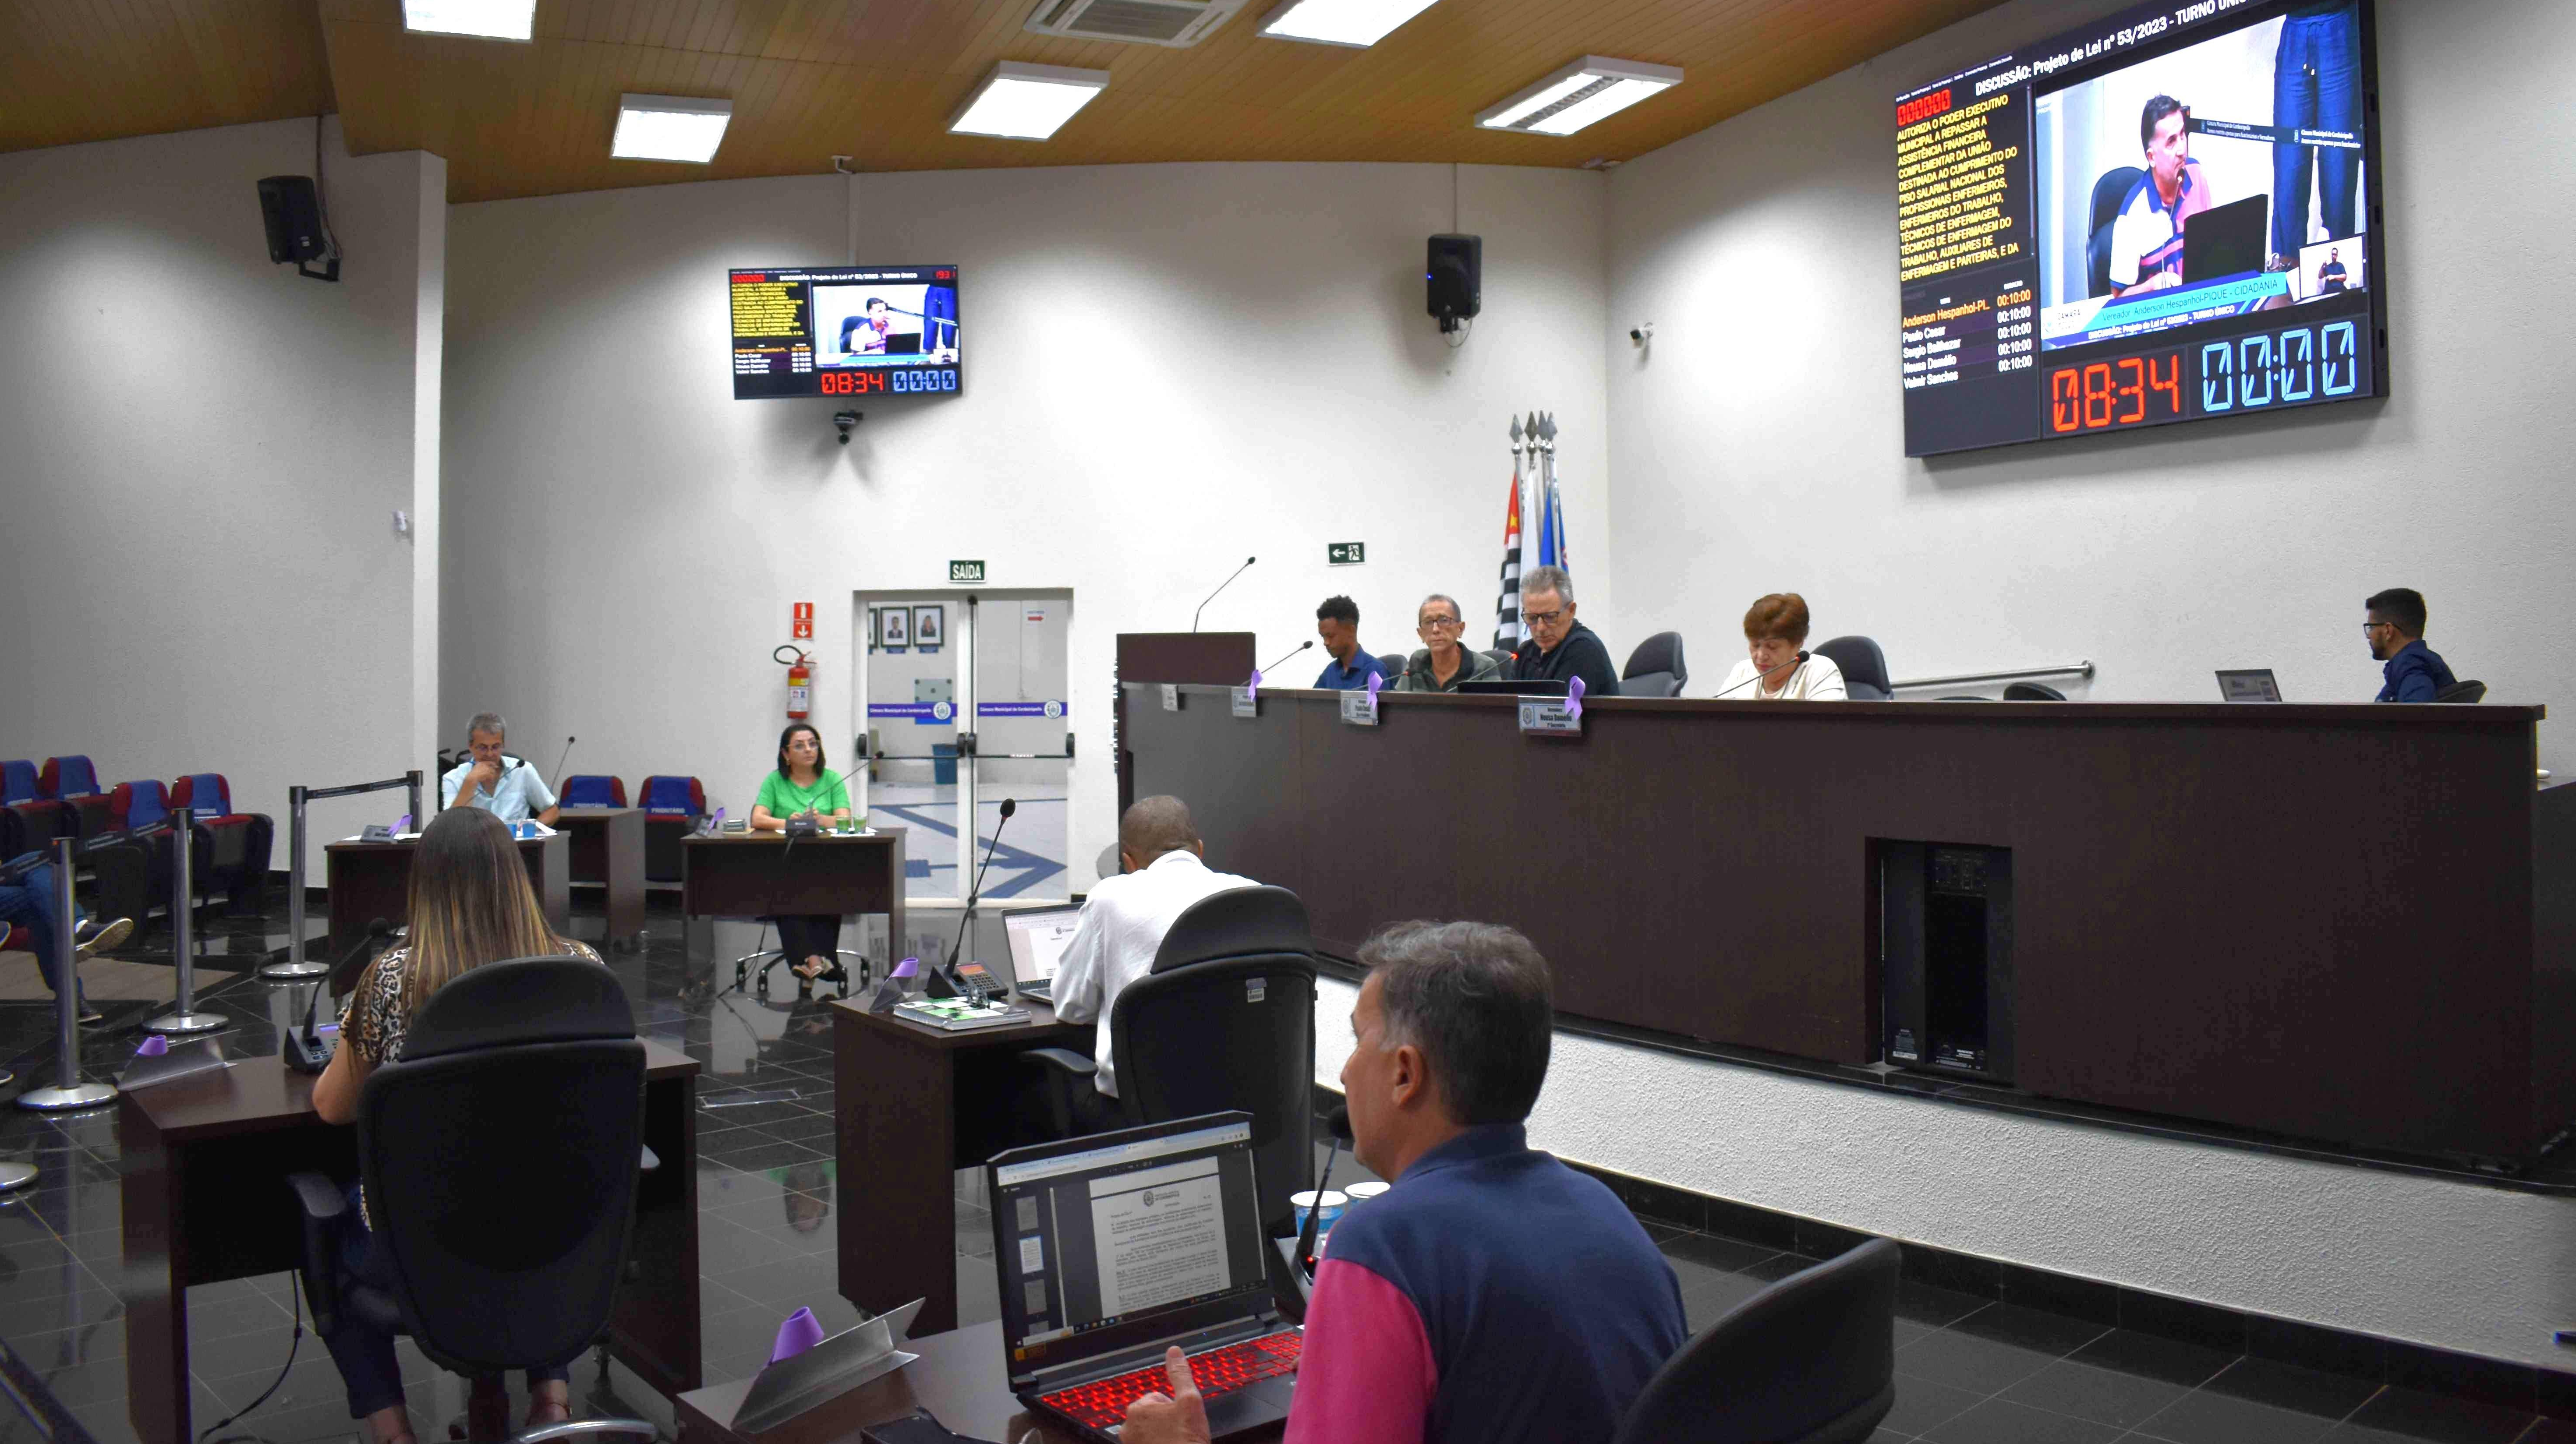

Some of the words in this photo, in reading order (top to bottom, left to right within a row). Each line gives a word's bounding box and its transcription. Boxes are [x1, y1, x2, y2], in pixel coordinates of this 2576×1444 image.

[1976, 66, 2031, 95] DISCUSSÃO:
[2034, 54, 2069, 75] Projeto
[2071, 48, 2084, 62] de
[2086, 39, 2101, 57] Lei
[2104, 35, 2115, 50] nº
[2117, 16, 2167, 45] 53/2023
[2176, 0, 2215, 25] TURNO
[1897, 122, 1931, 141] AUTORIZA
[1932, 119, 1938, 129] O
[1939, 109, 1964, 126] PODER
[1966, 95, 2008, 117] EXECUTIVO
[1898, 134, 1934, 153] MUNICIPAL
[1935, 131, 1940, 141] A
[1942, 118, 1980, 139] REPASSAR
[1981, 116, 1987, 126] A
[1898, 153, 1955, 179] COMPLEMENTAR
[1956, 149, 1967, 161] DA
[1968, 141, 1991, 156] UNIÃO
[1943, 130, 1986, 152] FINANCEIRA
[1899, 172, 1937, 192] DESTINADA
[1938, 168, 1949, 180] AO
[1950, 151, 2003, 176] CUMPRIMENTO
[2005, 147, 2017, 159] DO
[1899, 191, 1915, 204] PISO
[1917, 181, 1949, 199] SALARIAL
[1950, 170, 1986, 189] NACIONAL
[1988, 164, 2004, 177] DOS
[1900, 194, 1951, 217] PROFISSIONAIS
[1953, 177, 2007, 201] ENFERMEIROS,
[1900, 208, 1949, 230] ENFERMEIROS
[1950, 204, 1961, 215] DO
[1962, 192, 2003, 212] TRABALHO,
[1900, 225, 1935, 242] TÉCNICOS
[1936, 221, 1946, 233] DE
[1947, 207, 2000, 230] ENFERMAGEM,
[1900, 238, 1935, 255] TÉCNICOS
[1936, 234, 1946, 246] DE
[1948, 220, 1998, 243] ENFERMAGEM
[2000, 217, 2011, 229] DO
[1901, 251, 1939, 268] TRABALHO,
[1940, 239, 1981, 258] AUXILIARES
[1982, 235, 1993, 247] DE
[1901, 260, 1949, 281] ENFERMAGEM
[1950, 258, 1955, 269] E
[1957, 248, 1999, 267] PARTEIRAS,
[2001, 245, 2006, 256] E
[2007, 243, 2018, 254] DA
[1903, 313, 1936, 328] Anderson
[1997, 290, 2030, 307] 00:10:00
[2103, 308, 2130, 321] Vereador
[2134, 302, 2164, 315] Anderson
[2166, 289, 2227, 310] Hespanhol-PIQUE
[2234, 279, 2278, 297] CIDADANIA
[1903, 330, 1923, 343] Paulo
[1997, 306, 2031, 323] 00:10:00
[1998, 322, 2031, 339] 00:10:00
[1998, 339, 2031, 355] 00:10:00
[1999, 355, 2032, 372] 00:10:00
[821, 372, 883, 393] 08:34
[893, 370, 956, 392] 00:00
[2052, 355, 2179, 432] 08:34
[2202, 321, 2355, 411] 00:00
[952, 561, 981, 579] SAÍDA
